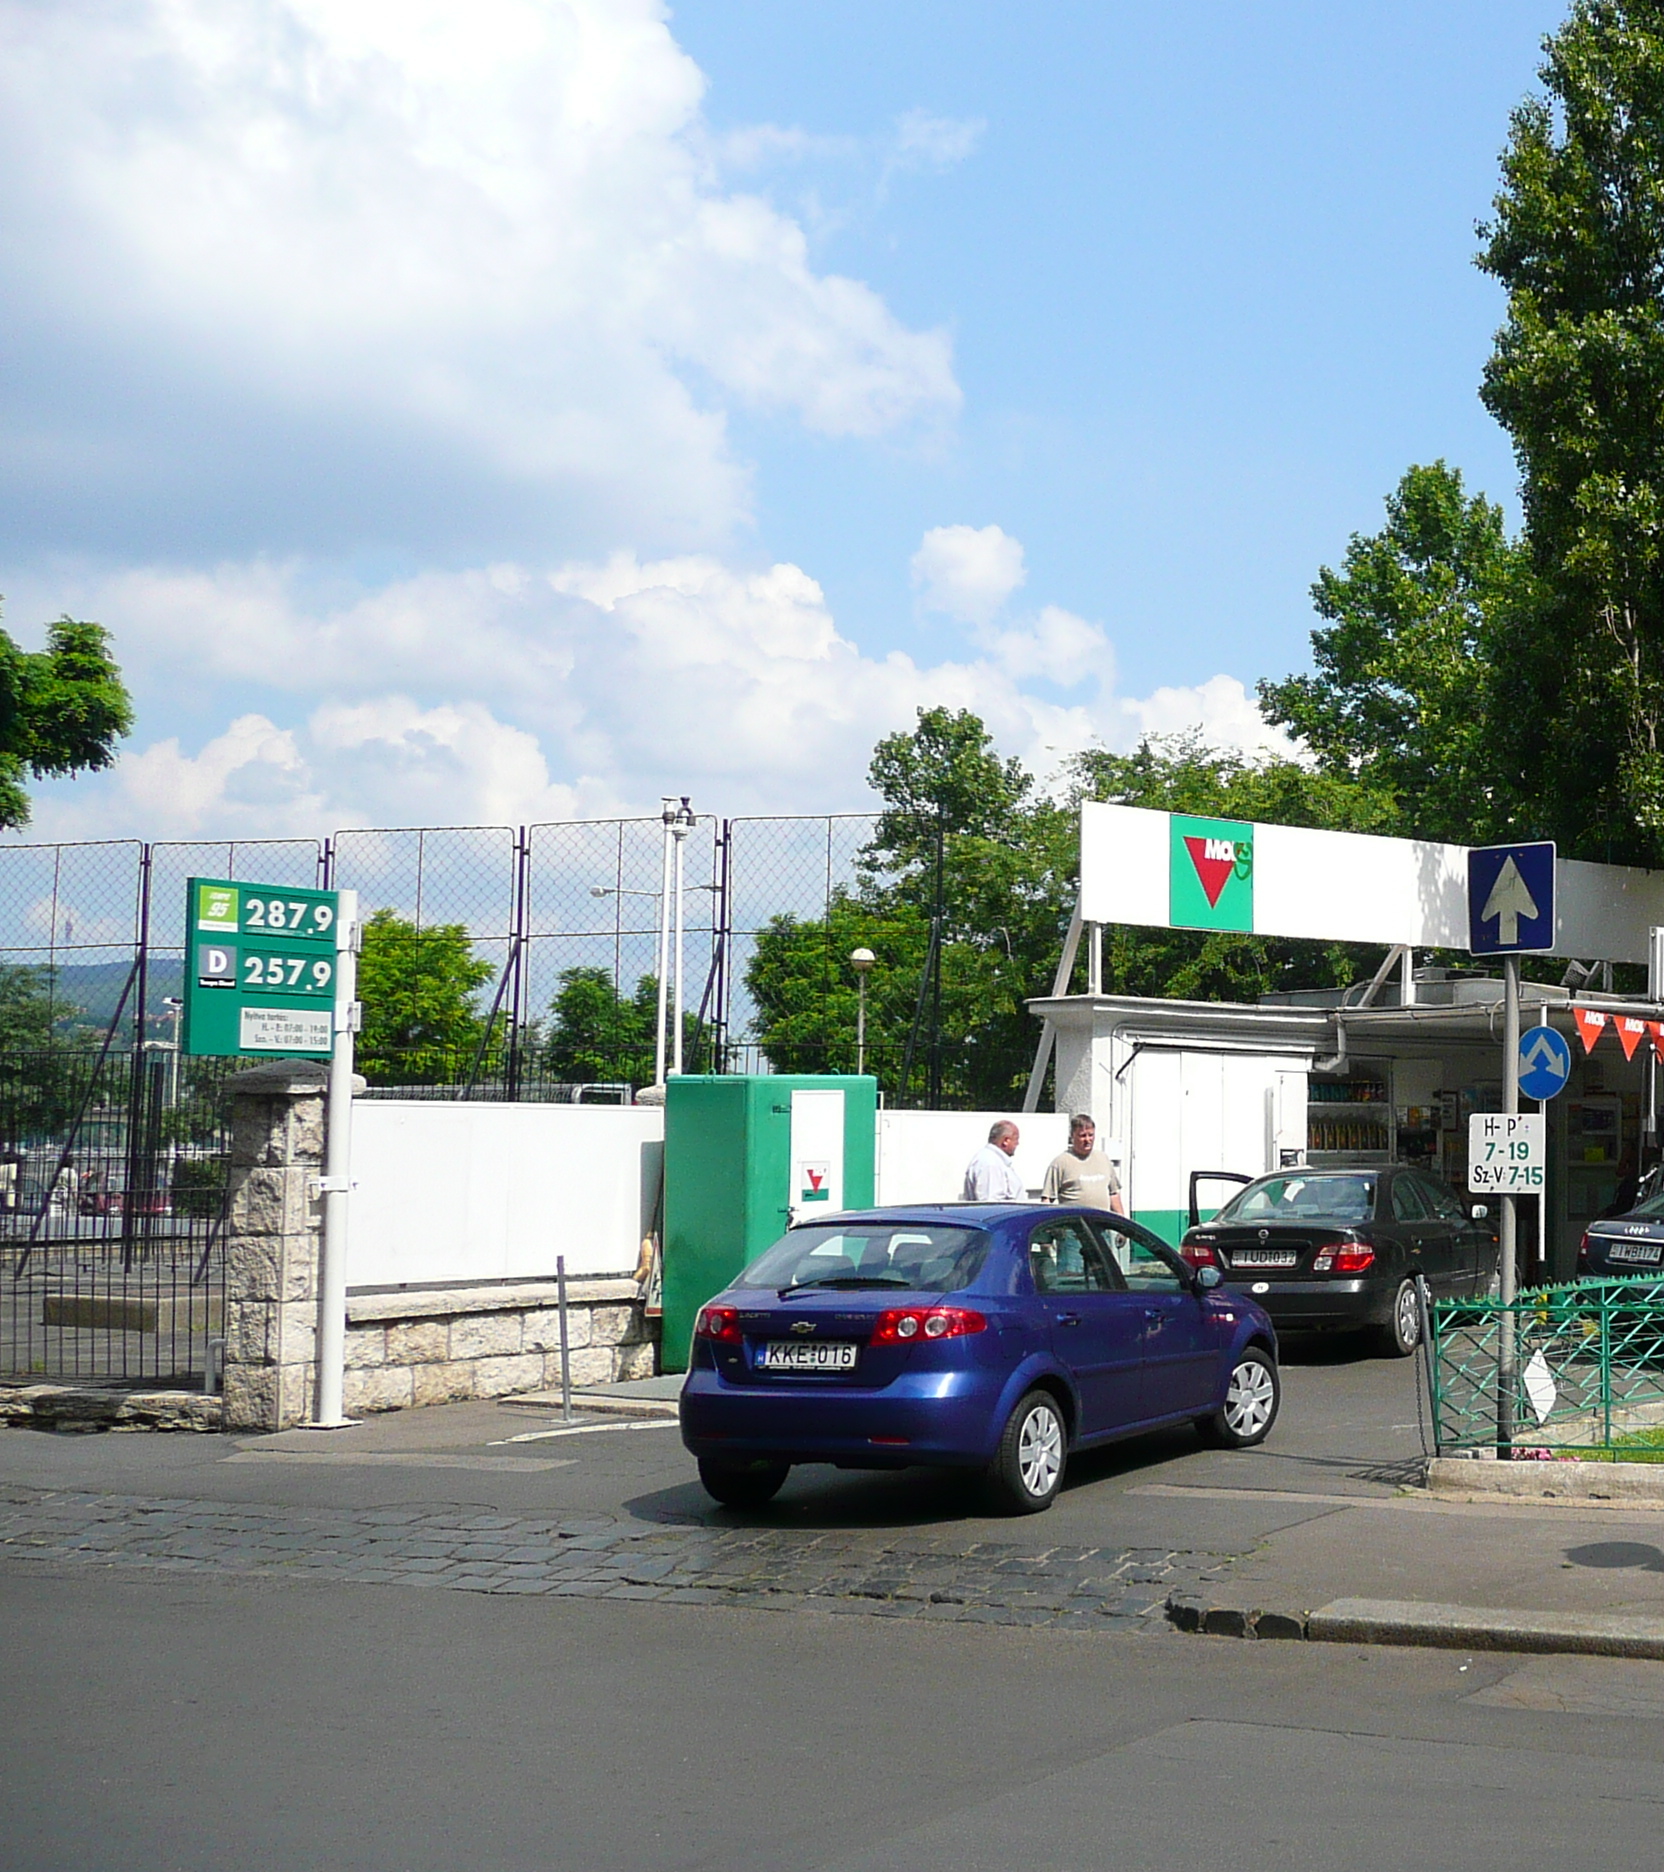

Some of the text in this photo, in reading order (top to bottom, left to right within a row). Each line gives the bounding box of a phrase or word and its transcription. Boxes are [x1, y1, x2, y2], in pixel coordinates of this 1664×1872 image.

[208, 902, 230, 917] 95
[245, 899, 333, 934] 287.9
[208, 950, 228, 973] D
[244, 957, 331, 990] 257.9
[1584, 1011, 1605, 1027] MOL
[1625, 1018, 1645, 1033] MOL
